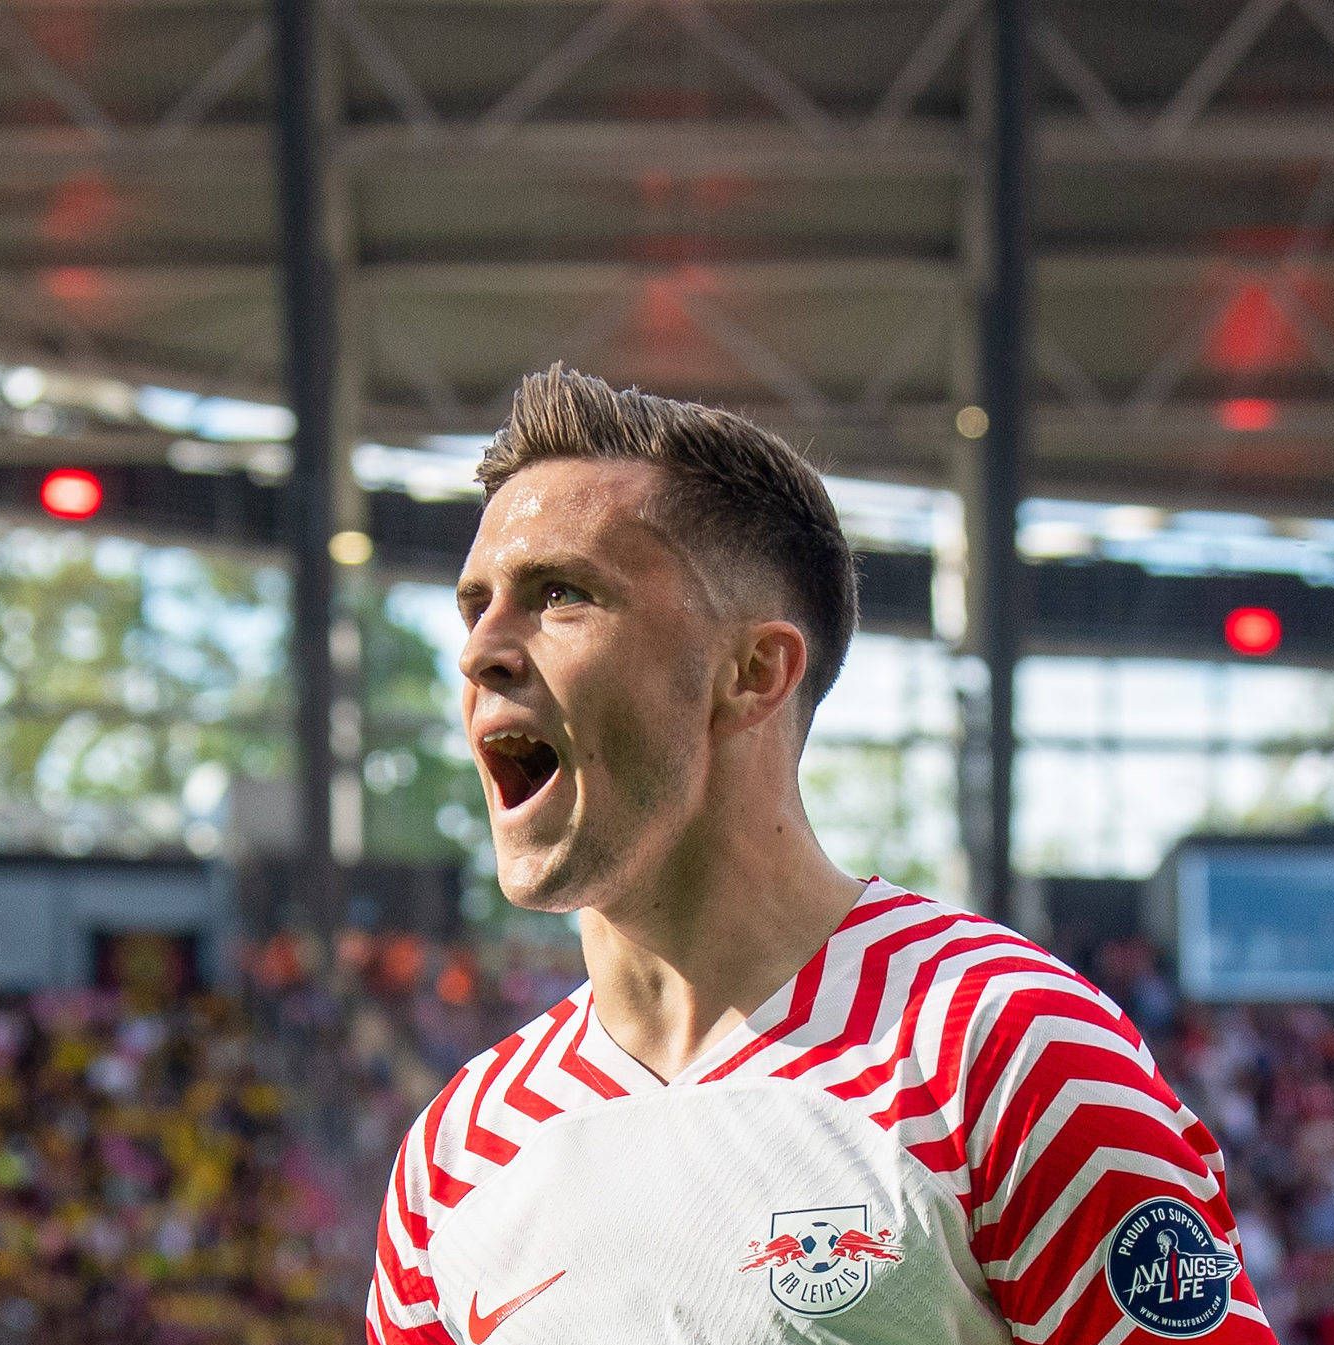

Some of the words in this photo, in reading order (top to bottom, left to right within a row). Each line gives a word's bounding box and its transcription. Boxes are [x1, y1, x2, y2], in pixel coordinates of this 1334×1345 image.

[1118, 1216, 1150, 1256] PROUD
[1150, 1208, 1166, 1223] TO
[1169, 1208, 1209, 1247] SUPPORT
[778, 1272, 800, 1294] RB
[800, 1268, 860, 1303] LEIPZIG
[1140, 1256, 1218, 1284] WINGS
[1159, 1277, 1205, 1304] LIFE
